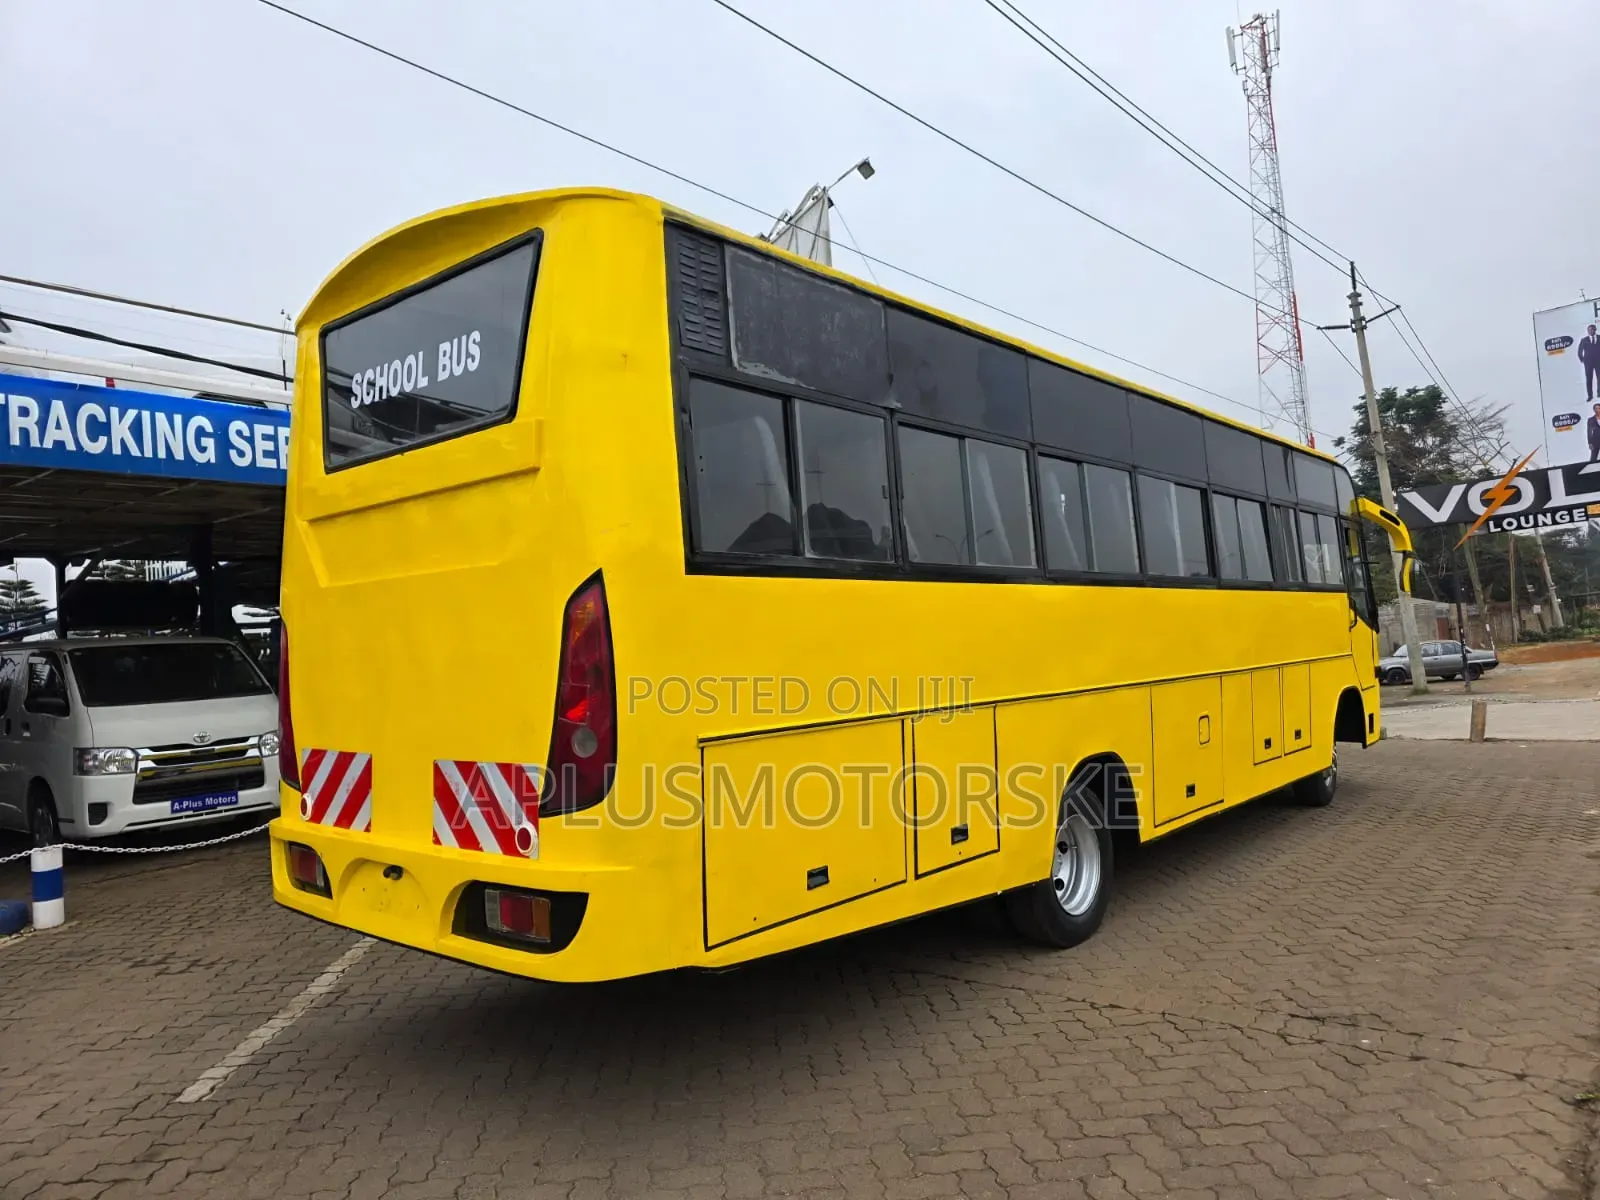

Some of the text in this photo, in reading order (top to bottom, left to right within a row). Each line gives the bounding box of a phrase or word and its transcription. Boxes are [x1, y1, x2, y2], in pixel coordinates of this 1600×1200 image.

[350, 330, 481, 409] SCHOOL BUS
[0, 393, 216, 464] RACKING
[1488, 508, 1587, 533] LOUNGE
[173, 795, 237, 811] A-Plus Motors
